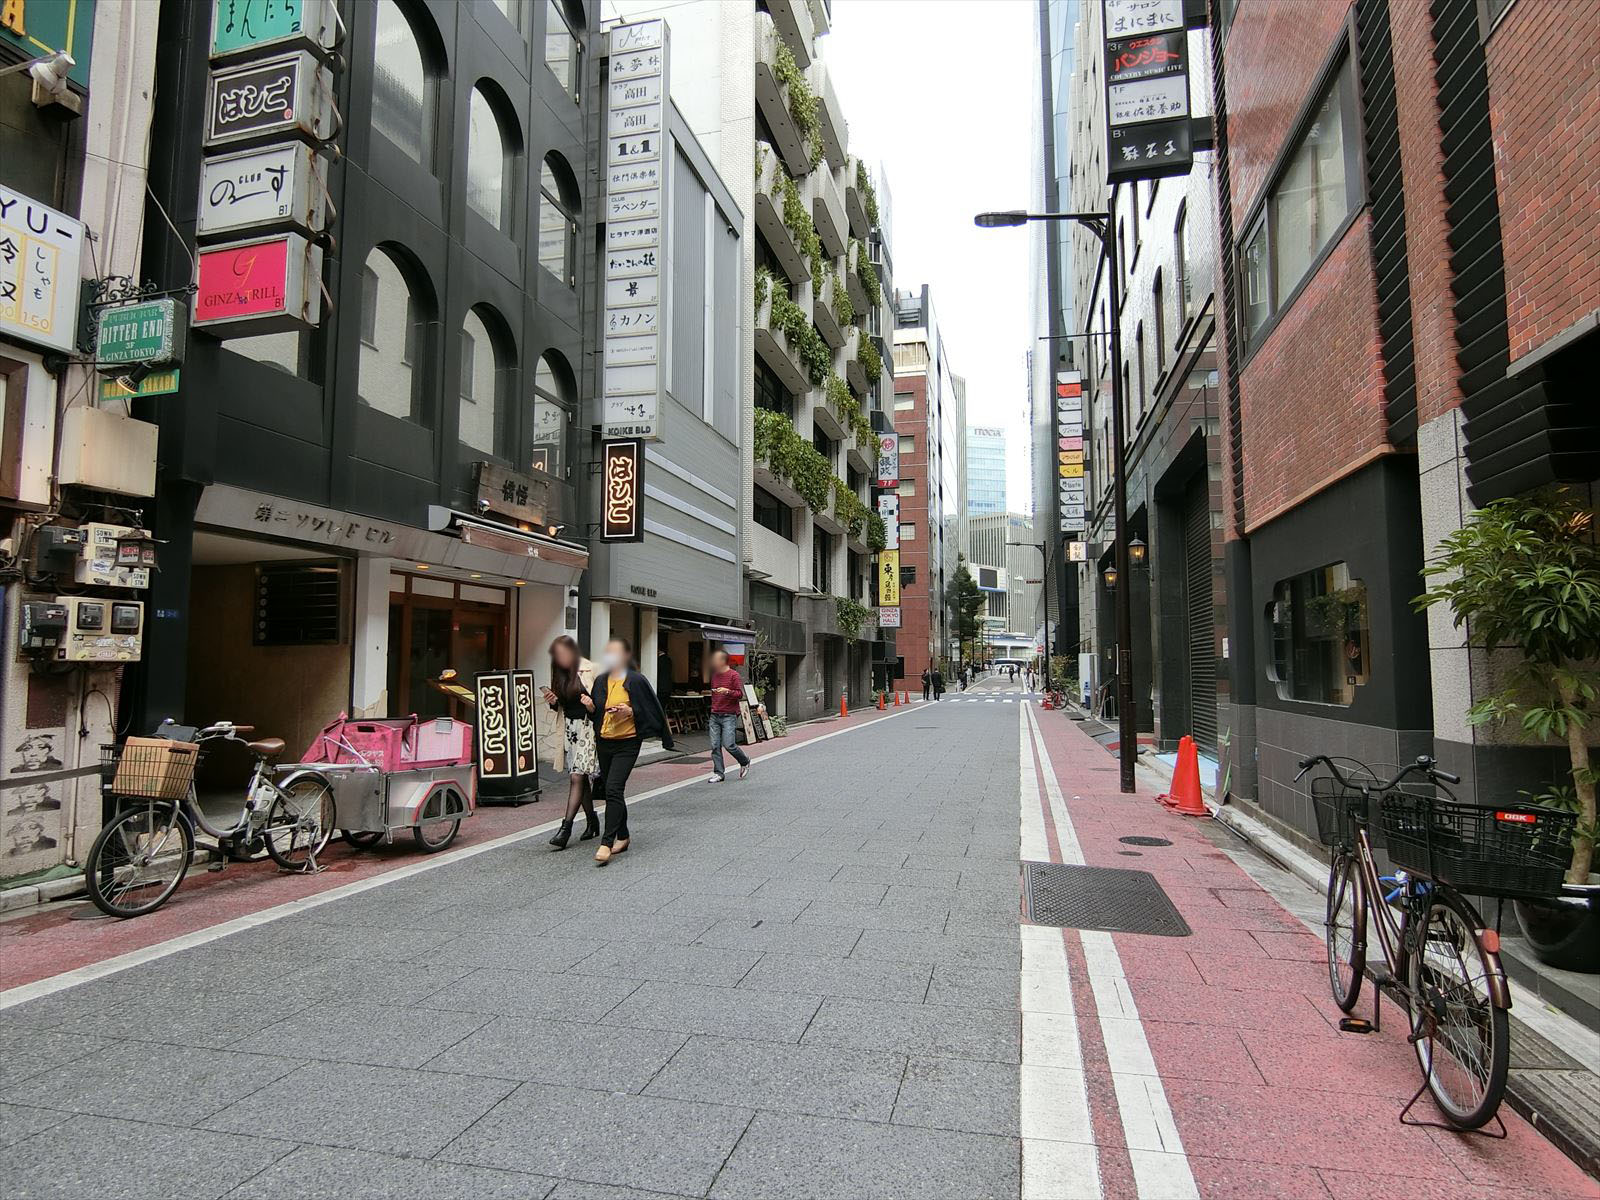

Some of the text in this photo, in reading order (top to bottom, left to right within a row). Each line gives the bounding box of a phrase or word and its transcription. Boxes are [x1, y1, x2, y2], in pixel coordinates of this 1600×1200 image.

[1114, 12, 1174, 32] まにまに
[1110, 42, 1123, 51] 3F
[1110, 64, 1183, 81] COUNTRY MUSIC LIVE
[1112, 86, 1126, 94] 1F
[1113, 129, 1126, 138] B1
[618, 139, 652, 157] 1&1
[238, 173, 262, 185] CLUB
[278, 204, 288, 216] B1
[613, 200, 656, 213] ラベンダー
[34, 246, 51, 300] ししゃも
[204, 292, 241, 308] GINZA
[244, 286, 279, 302] TRILL
[23, 311, 50, 330] 150
[620, 313, 655, 327] カノン
[102, 318, 163, 345] BITTER END
[106, 346, 155, 361] GINZA TOKYO
[608, 425, 652, 436] KOIKE BLD
